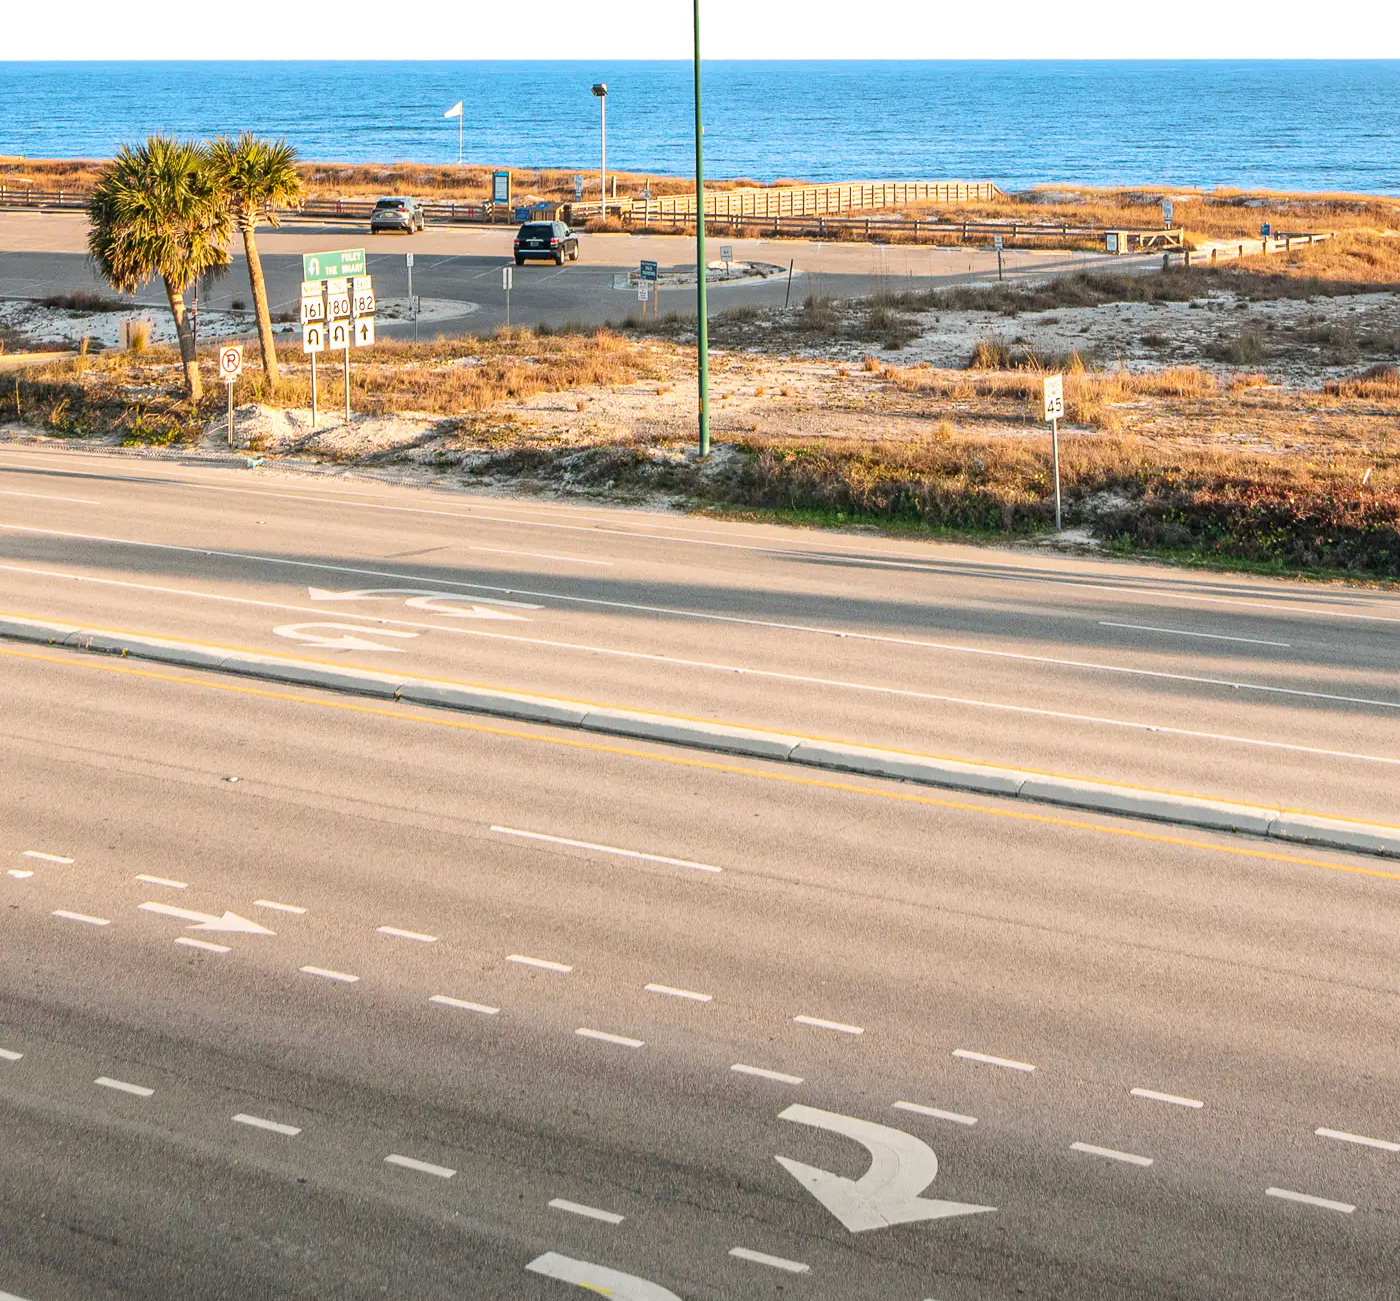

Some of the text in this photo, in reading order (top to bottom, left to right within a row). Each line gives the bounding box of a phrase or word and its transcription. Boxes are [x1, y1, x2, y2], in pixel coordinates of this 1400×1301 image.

[341, 251, 361, 262] FOLEY
[325, 263, 363, 275] THE WHARF
[304, 302, 321, 318] 161
[328, 299, 348, 315] 180
[354, 295, 373, 312] 182
[1047, 397, 1062, 414] 45
